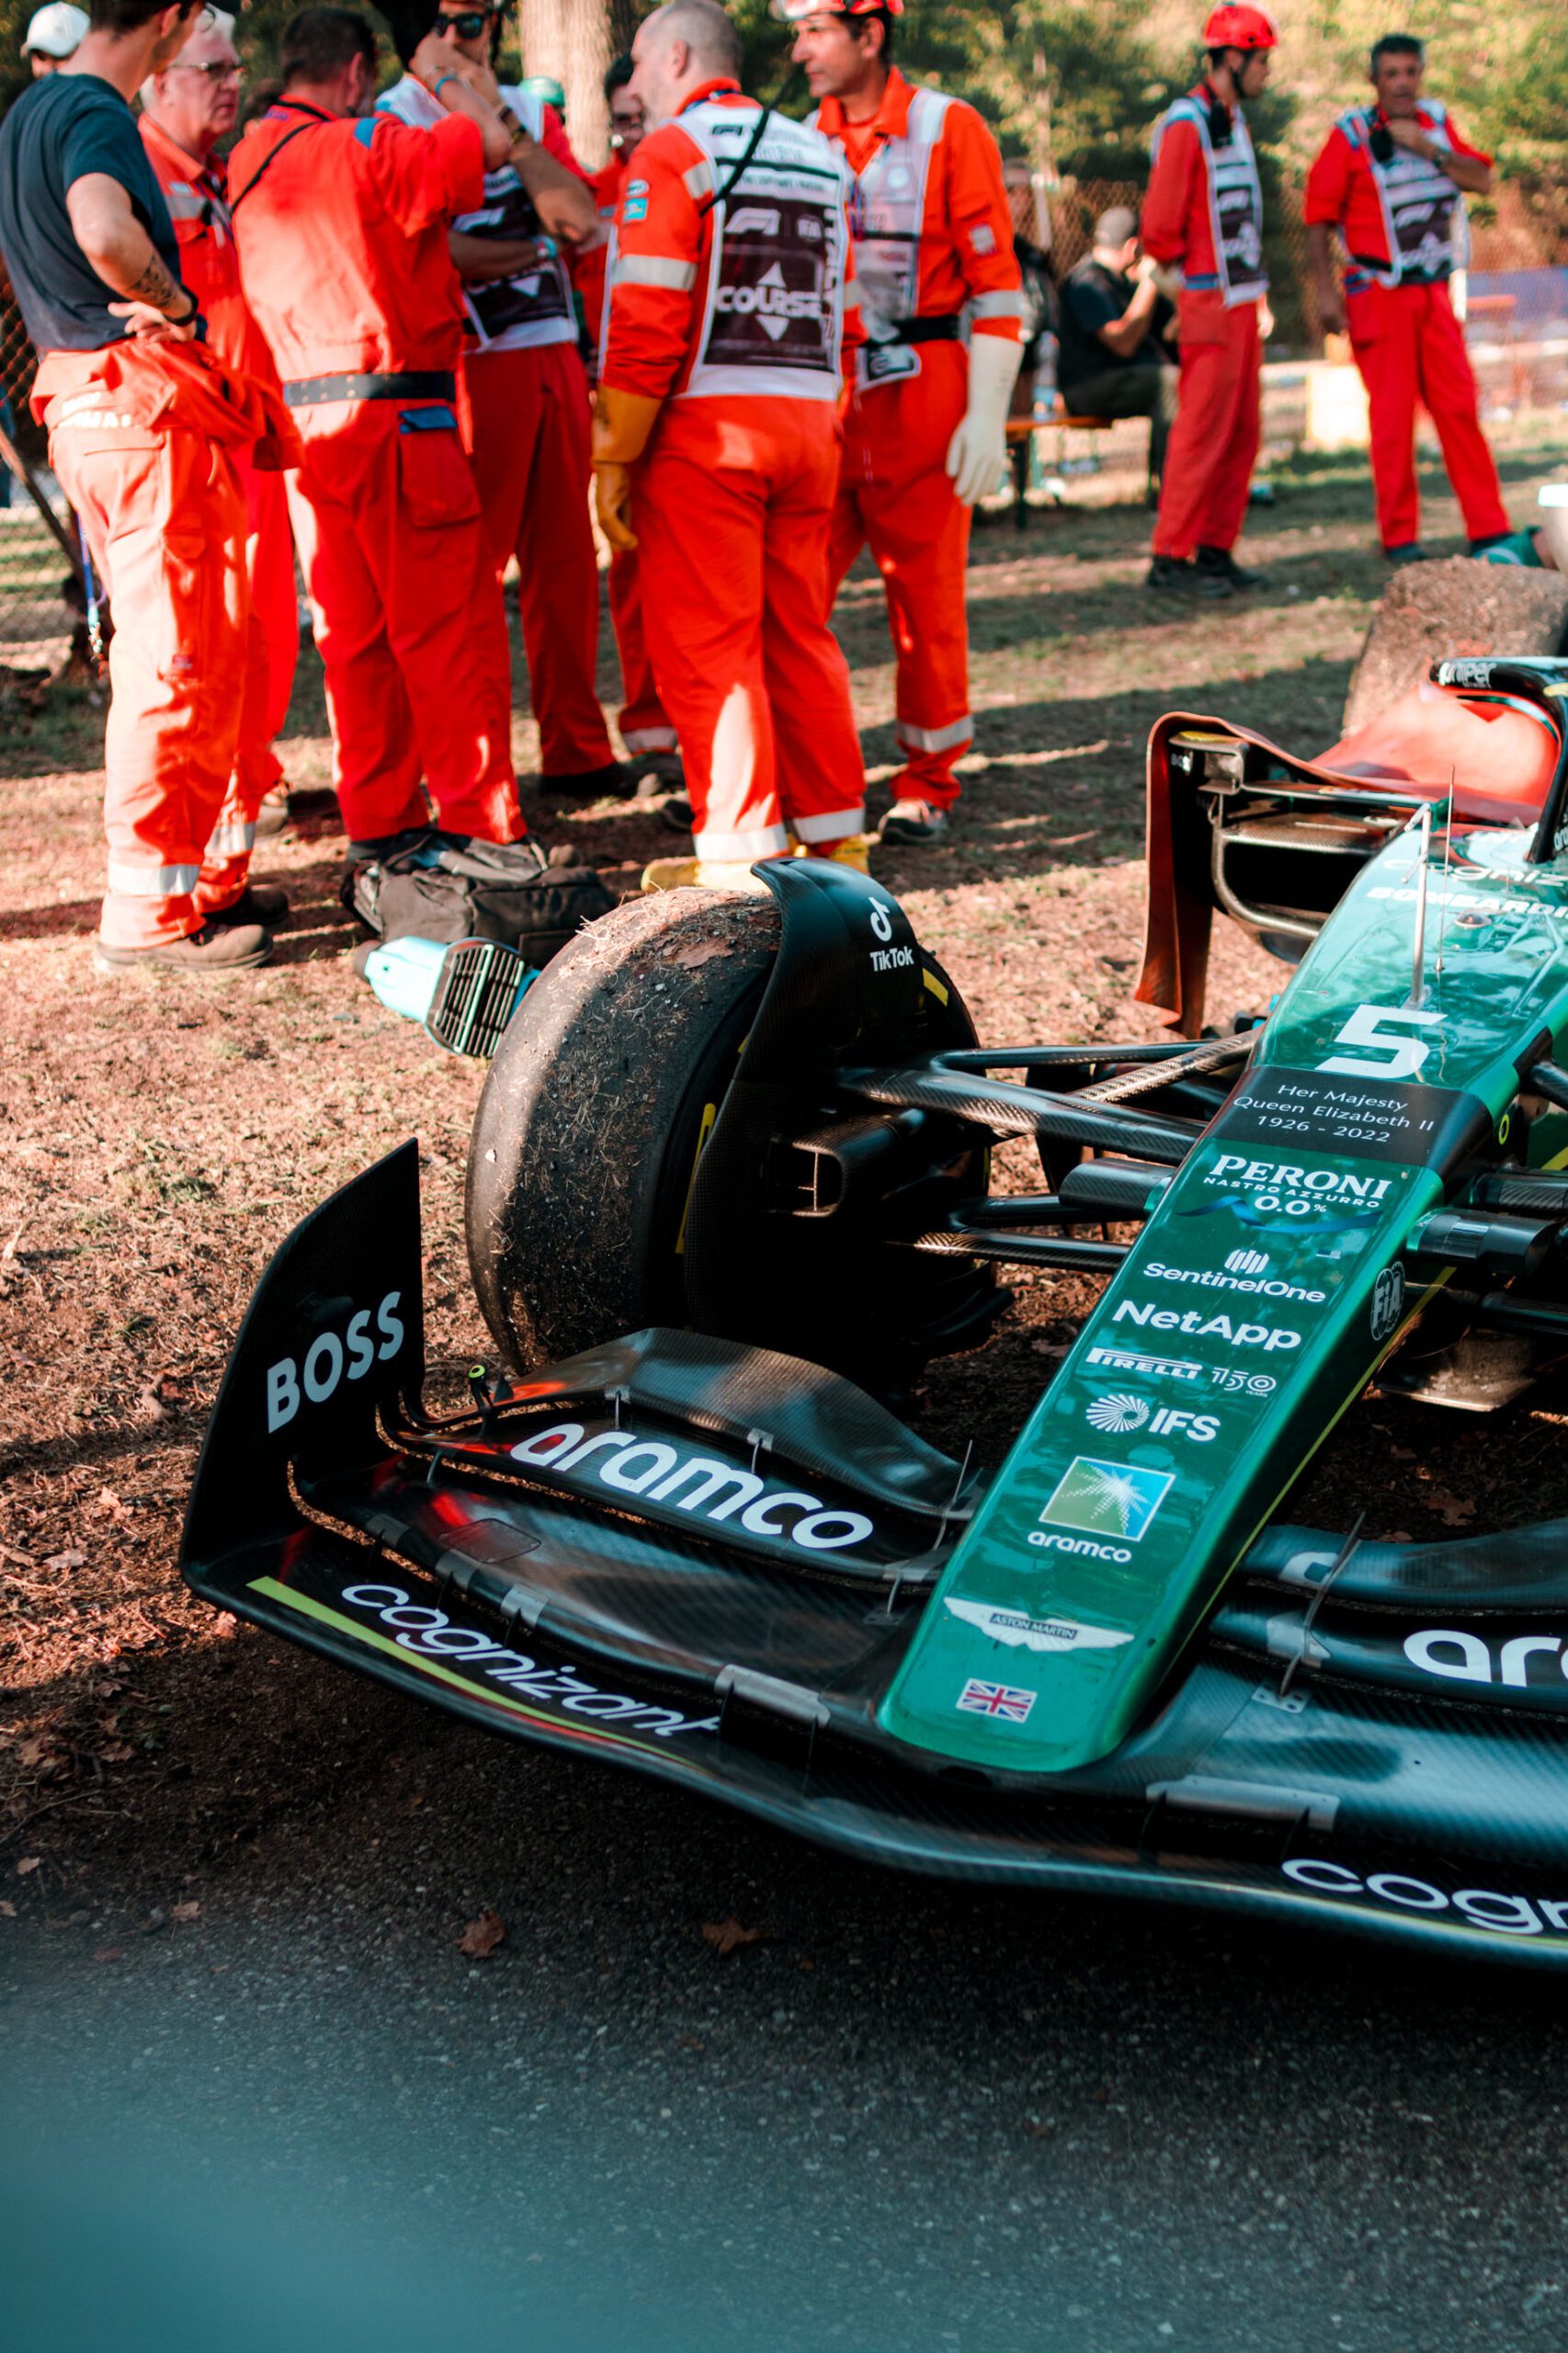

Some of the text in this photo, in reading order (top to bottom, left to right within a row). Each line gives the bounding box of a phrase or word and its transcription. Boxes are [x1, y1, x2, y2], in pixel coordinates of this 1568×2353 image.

[717, 285, 822, 318] COURSE
[1366, 886, 1568, 920] BOMBARDI
[870, 946, 914, 972] TikTok
[1314, 1004, 1448, 1079] 5
[1233, 1097, 1305, 1114] Queen
[1312, 1106, 1411, 1129] Elizabeth
[1278, 1085, 1408, 1112] Her Majesty
[1256, 1116, 1311, 1132] 1926
[1333, 1126, 1391, 1142] 2022
[1203, 1176, 1380, 1208] NASTRO AZZURRO
[1209, 1154, 1393, 1199] PERONI
[1142, 1262, 1326, 1302] SentinelOne
[1112, 1300, 1301, 1351] NetApp
[267, 1290, 404, 1435] BOSS
[1085, 1347, 1203, 1380] PIRELLI
[1149, 1407, 1221, 1442] IFS
[510, 1423, 874, 1550] aramco
[1028, 1531, 1132, 1563] aramco
[993, 1614, 1074, 1639] ASTON MARTIN
[341, 1584, 721, 1737] cognizant
[1403, 1629, 1568, 1688] ar
